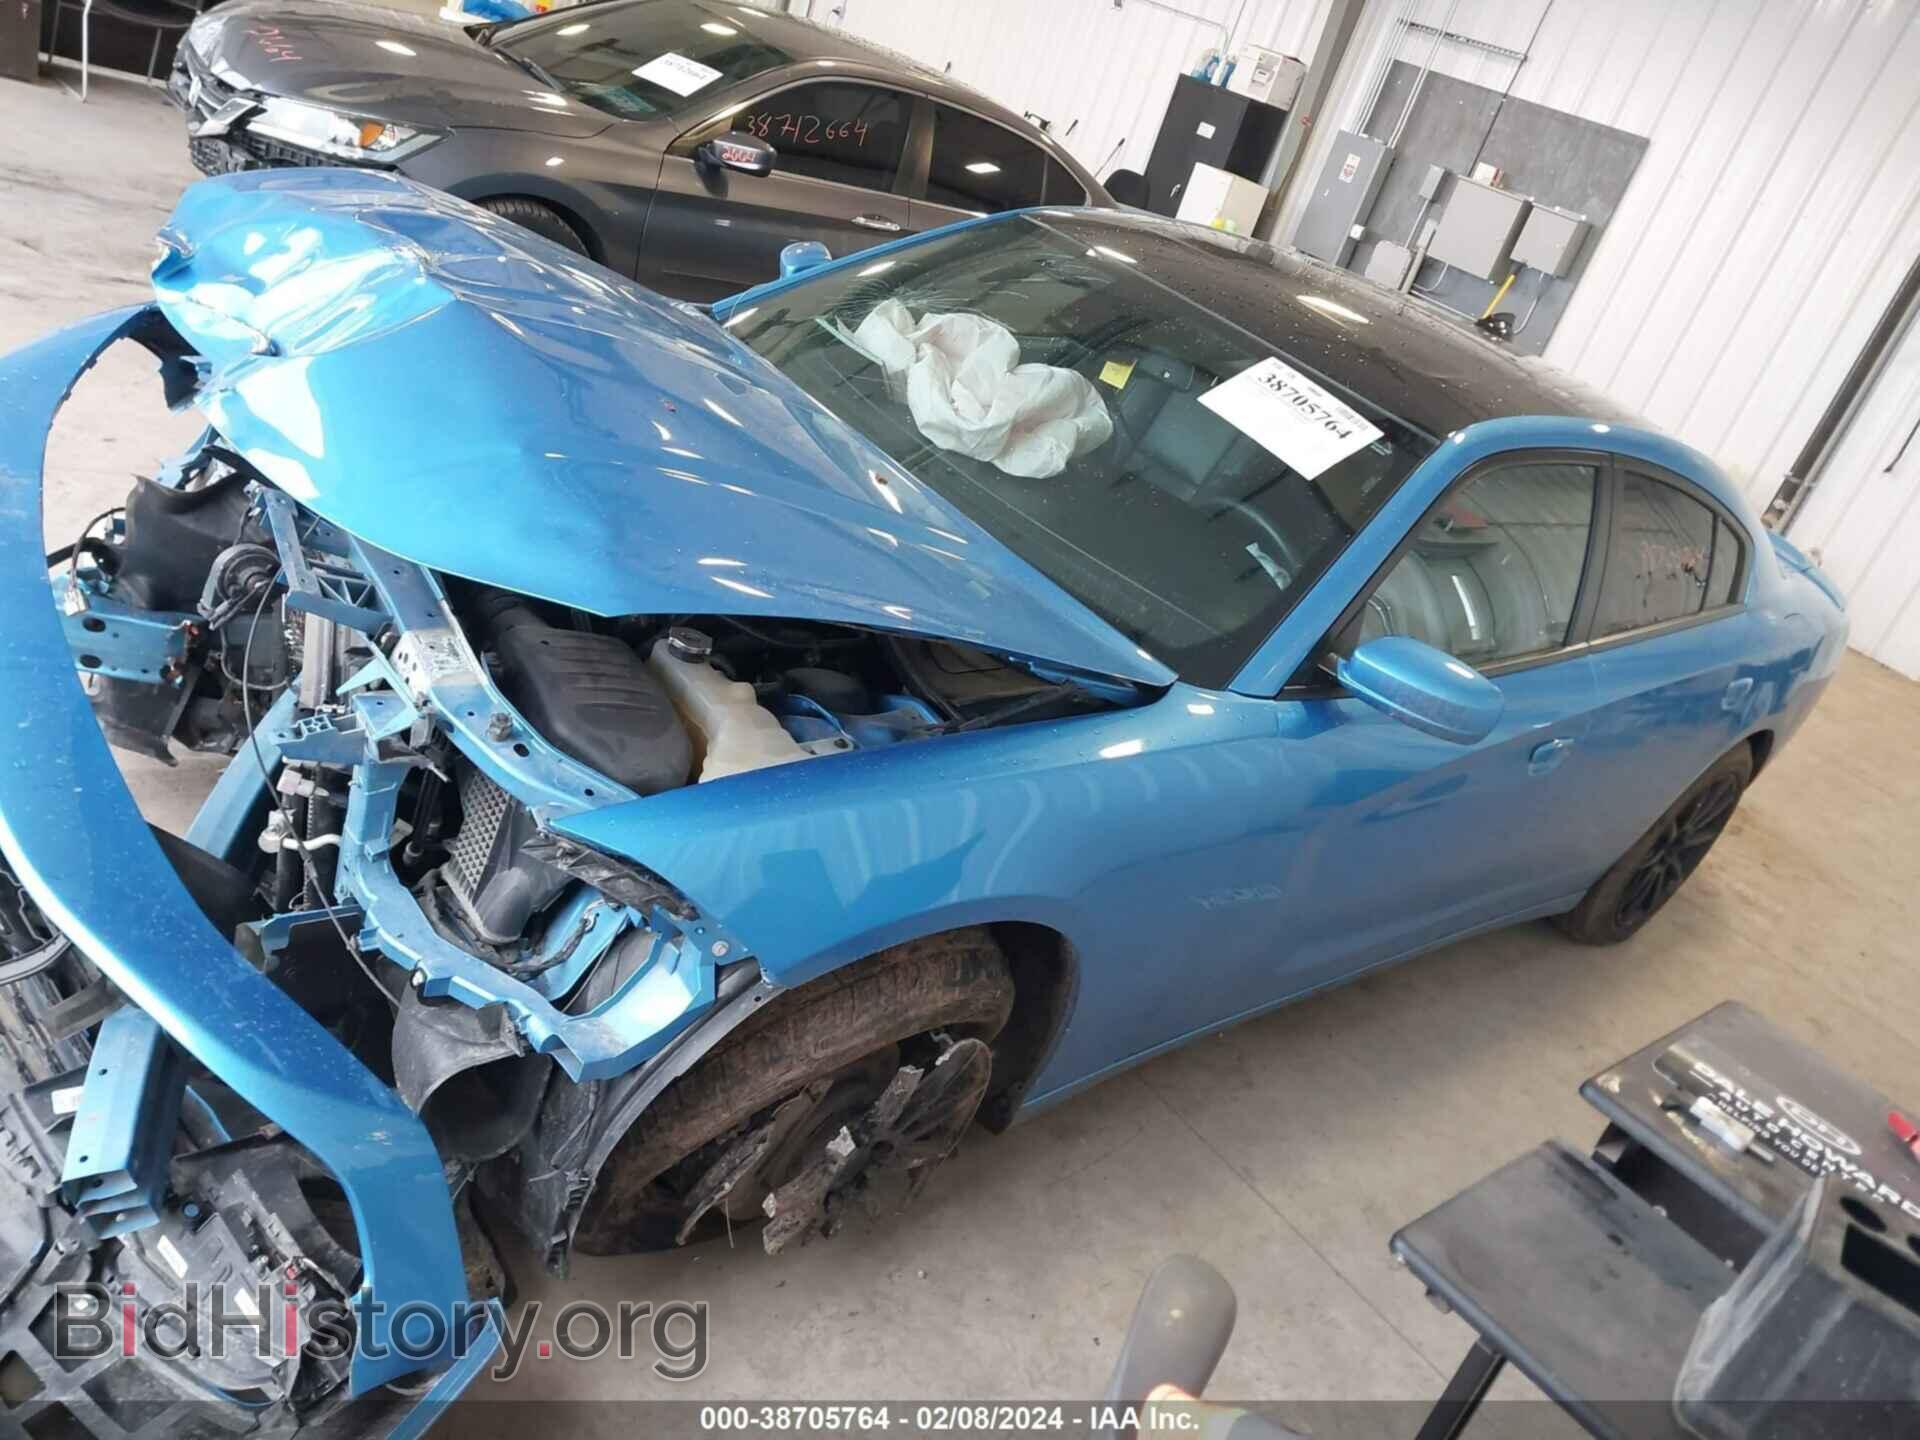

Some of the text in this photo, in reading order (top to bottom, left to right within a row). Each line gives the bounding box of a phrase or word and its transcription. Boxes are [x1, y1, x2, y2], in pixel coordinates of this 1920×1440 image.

[748, 111, 868, 147] 38712664
[1258, 373, 1353, 440] 38705764
[1718, 1091, 1781, 1134] AUTO
[1693, 1061, 1920, 1219] DALE HOWARD
[1774, 1137, 1800, 1159] YOU
